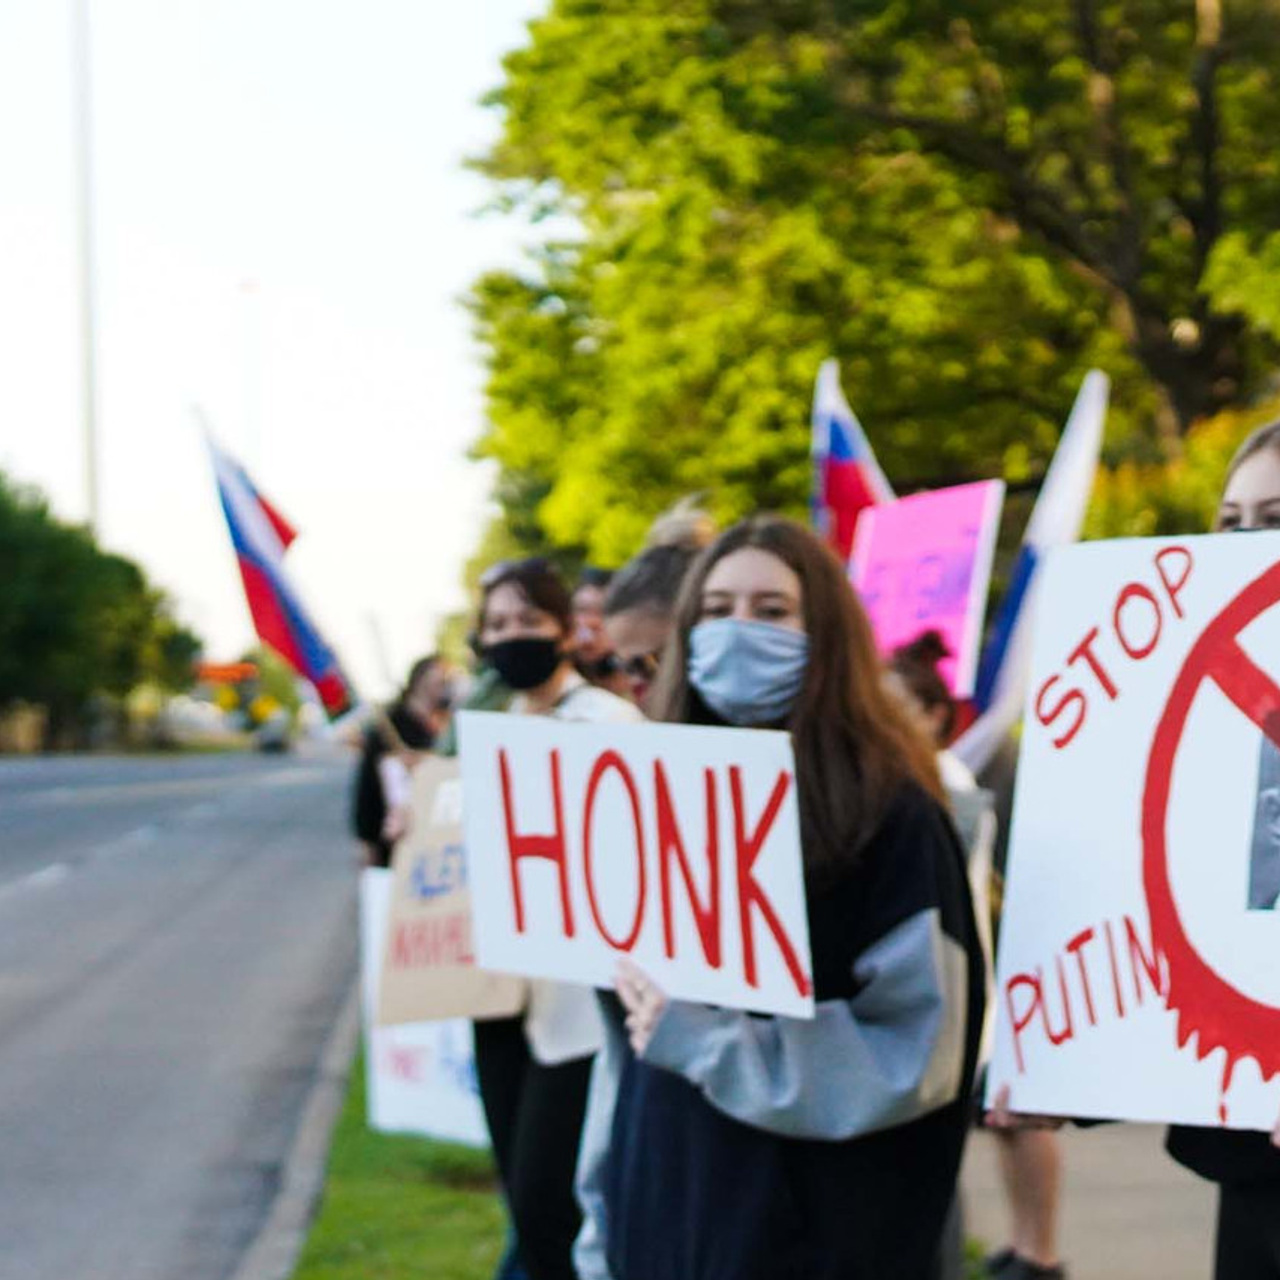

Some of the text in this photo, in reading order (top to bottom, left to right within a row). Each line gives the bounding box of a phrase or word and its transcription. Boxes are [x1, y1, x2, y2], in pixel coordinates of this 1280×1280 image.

[1034, 545, 1193, 750] STOP
[498, 748, 812, 997] HONK
[1004, 914, 1170, 1074] PUTIN
